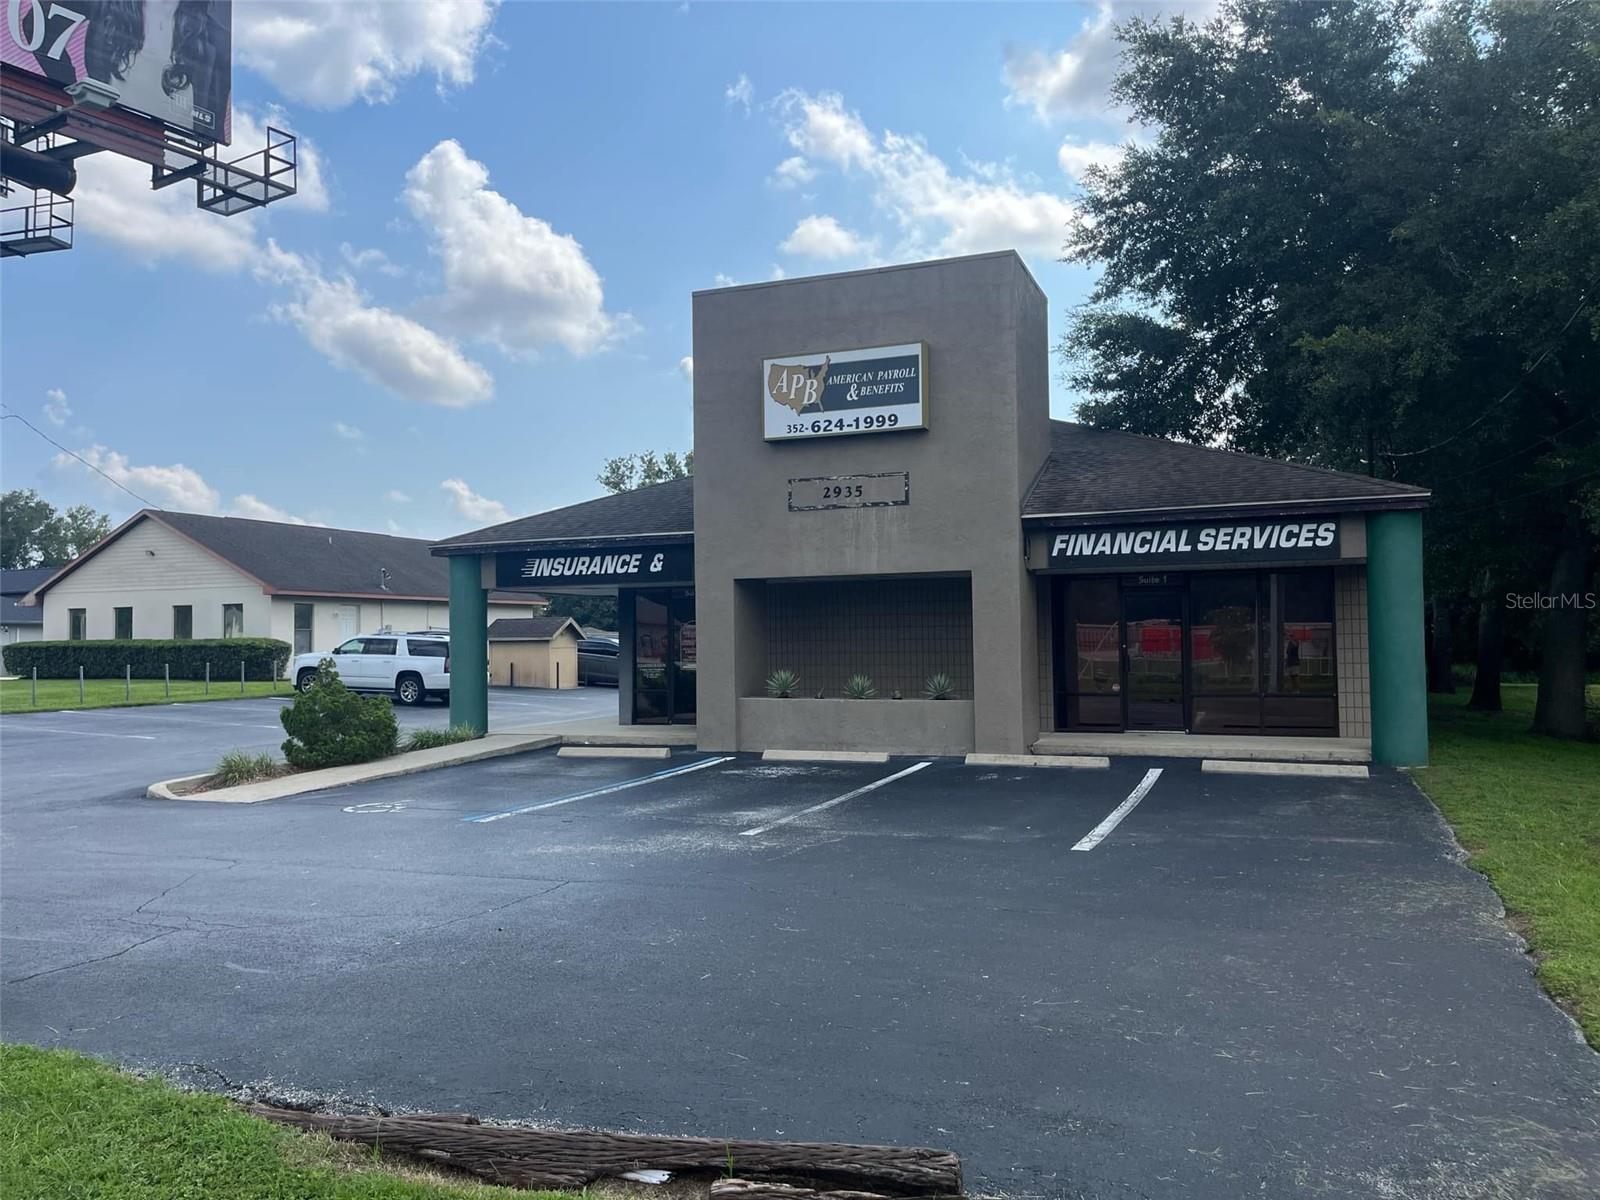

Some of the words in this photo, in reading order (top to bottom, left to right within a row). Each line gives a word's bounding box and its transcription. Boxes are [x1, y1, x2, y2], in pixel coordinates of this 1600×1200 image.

[826, 371, 874, 386] AMERICAN
[877, 367, 917, 381] PAYROLL
[772, 368, 818, 405] APB
[846, 383, 859, 401] &
[860, 382, 905, 397] BENEFITS
[823, 485, 863, 499] 2935
[1051, 528, 1192, 557] FINANCIAL
[1197, 522, 1336, 551] SERVICES
[522, 553, 642, 578] INSURANCE
[650, 553, 664, 572] &
[1138, 575, 1160, 585] Suite
